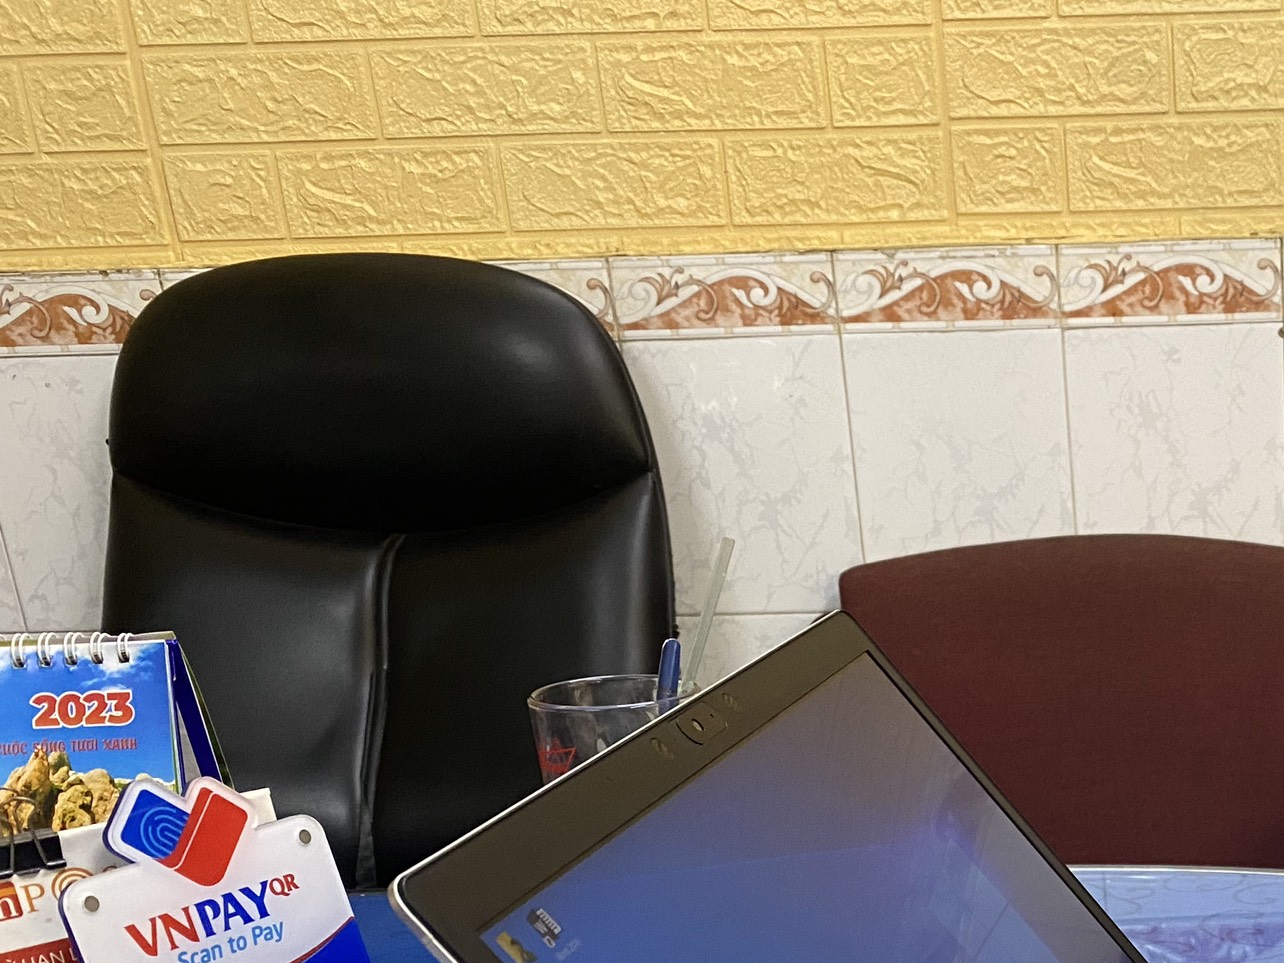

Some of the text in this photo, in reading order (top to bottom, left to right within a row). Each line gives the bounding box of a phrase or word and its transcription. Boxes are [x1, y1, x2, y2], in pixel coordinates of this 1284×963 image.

[30, 690, 135, 729] 2023
[102, 737, 138, 751] XANH
[124, 873, 300, 957] VNPAY QR
[227, 935, 248, 954] to
[251, 921, 284, 947] Pay
